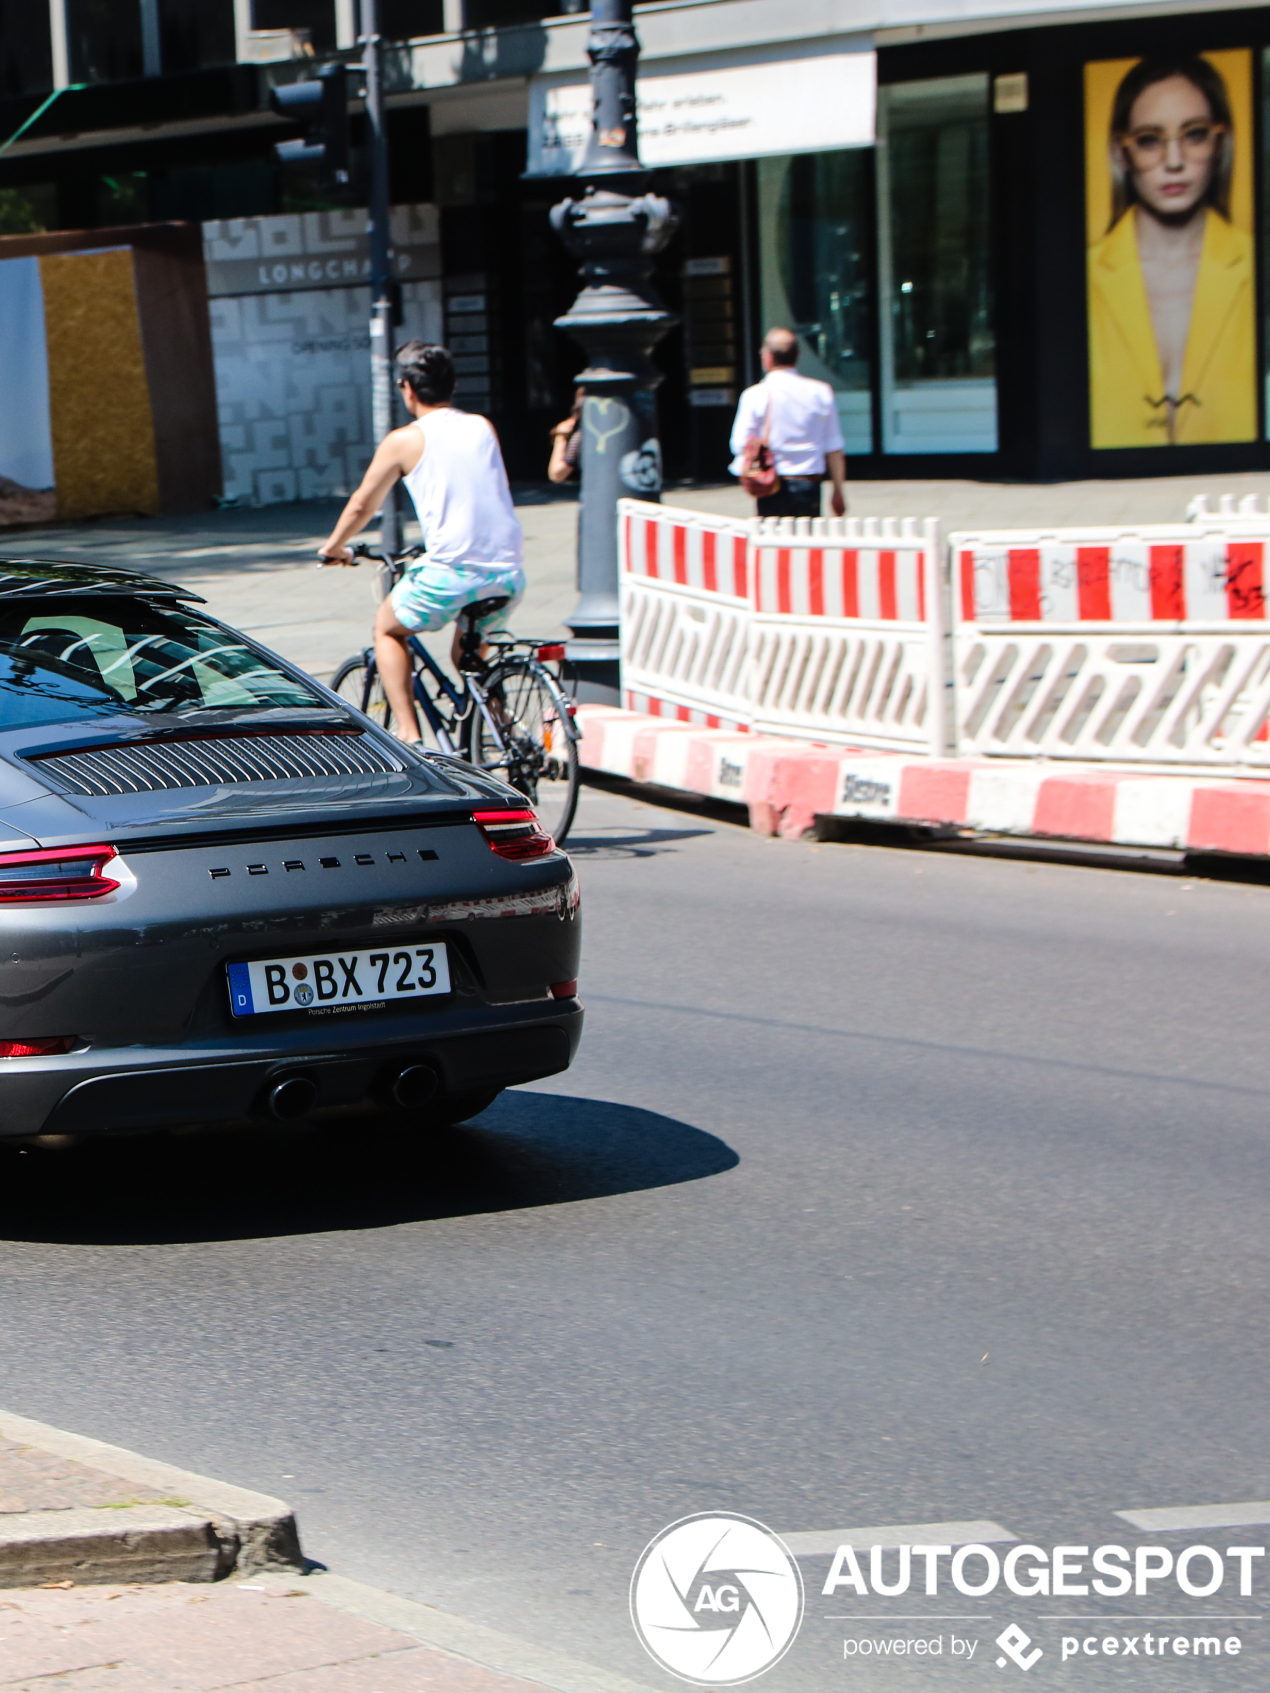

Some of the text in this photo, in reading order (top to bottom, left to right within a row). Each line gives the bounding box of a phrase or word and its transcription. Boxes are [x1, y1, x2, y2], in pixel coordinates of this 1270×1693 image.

[258, 253, 412, 285] LONGCHAP
[207, 849, 440, 880] PORSCHE
[264, 948, 437, 1006] B BX 723
[237, 994, 247, 1007] D
[308, 1007, 331, 1016] Porsche
[332, 1004, 357, 1014] Zentrum
